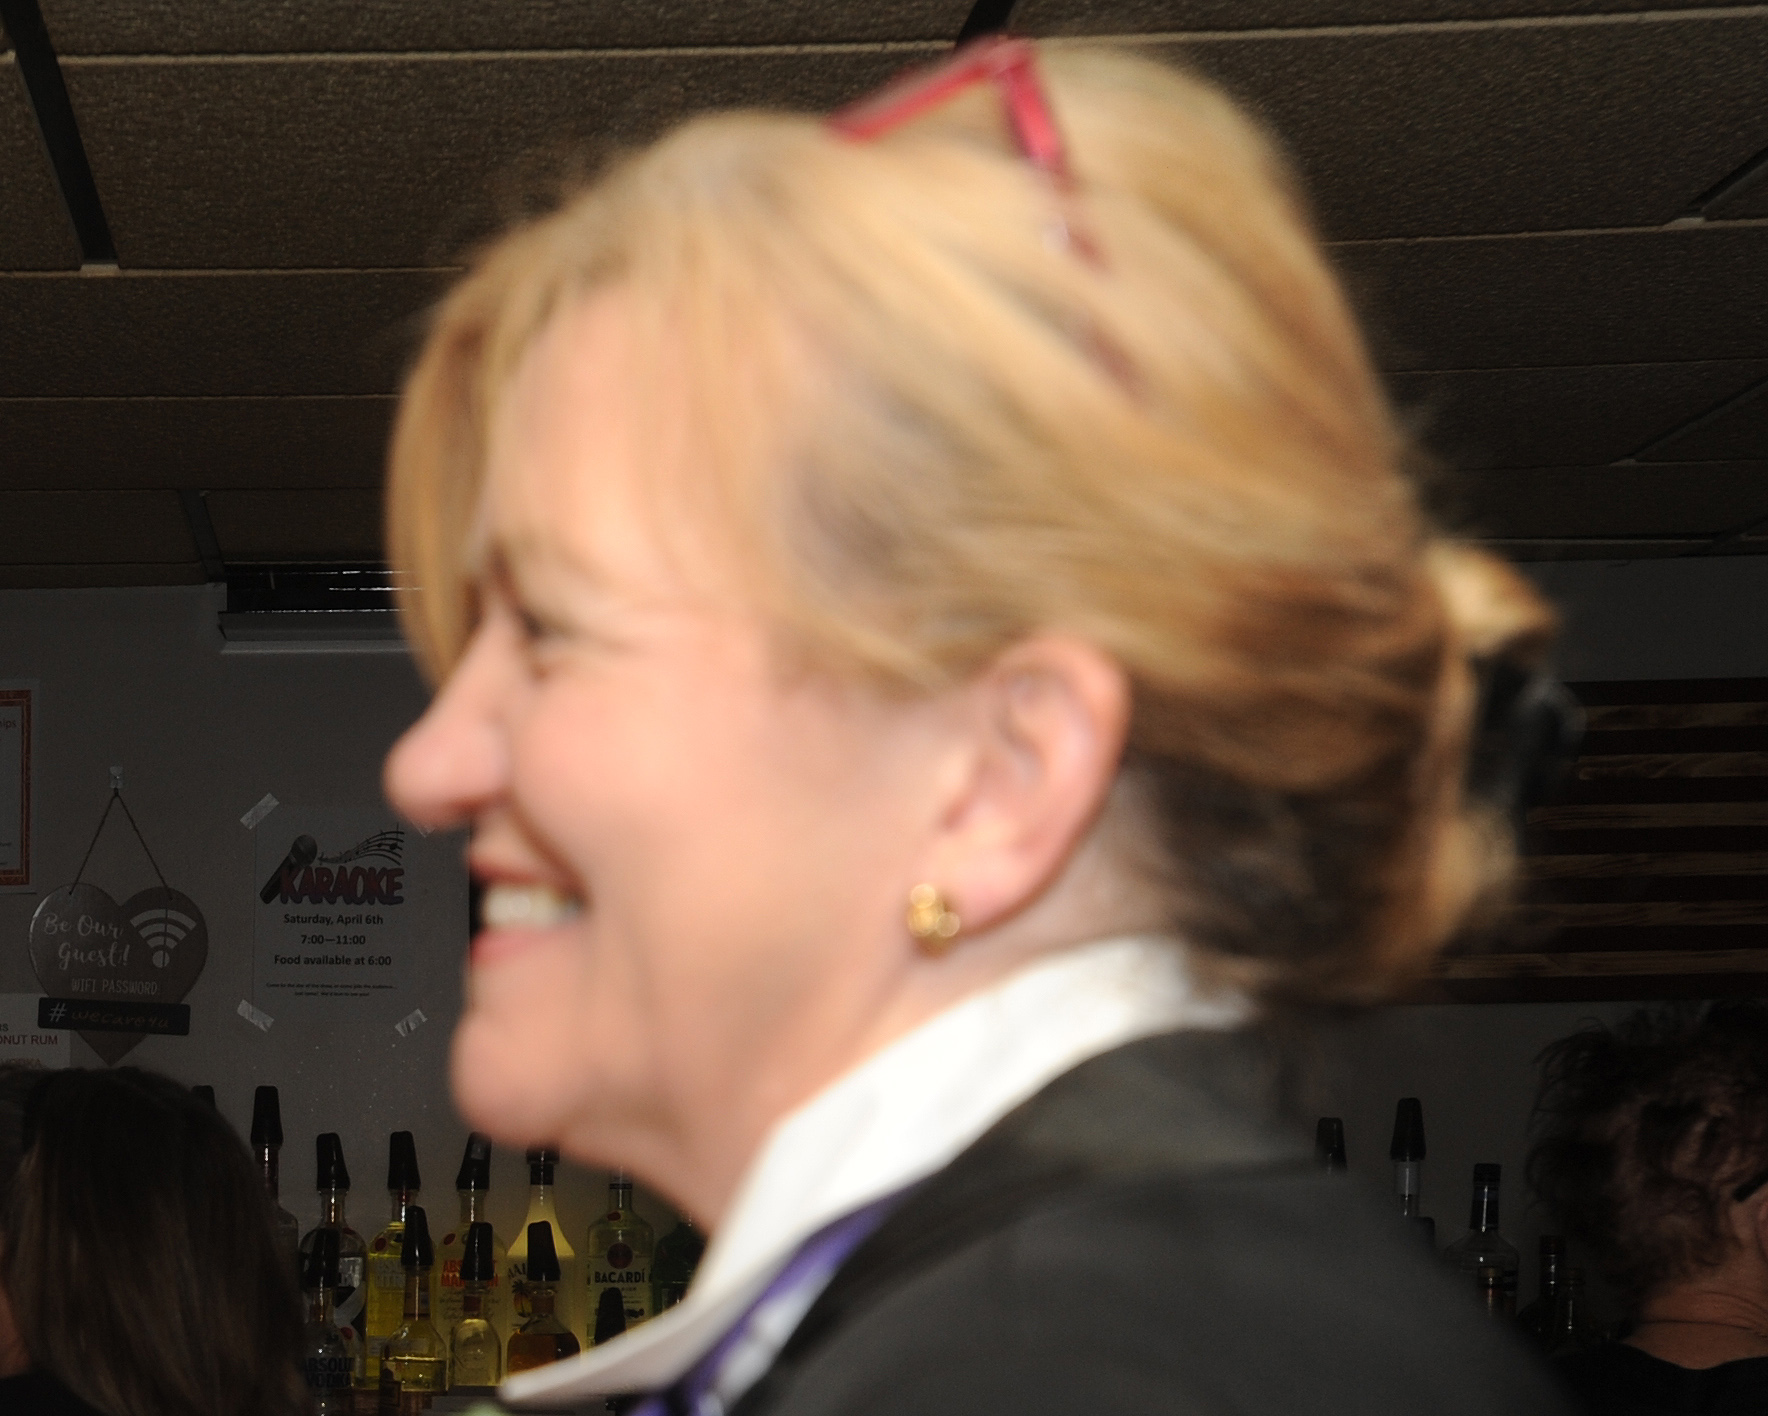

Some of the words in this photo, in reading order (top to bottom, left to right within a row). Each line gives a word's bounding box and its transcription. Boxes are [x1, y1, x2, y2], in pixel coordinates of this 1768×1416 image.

[280, 865, 404, 905] KARAOKE
[44, 912, 71, 935] Be
[78, 914, 124, 940] Our
[284, 913, 333, 926] Saturday,
[337, 914, 363, 926] April
[365, 914, 384, 925] 6th
[58, 942, 130, 971] Guest!
[274, 955, 301, 965] Food
[304, 955, 352, 966] available
[354, 956, 365, 966] at
[368, 956, 392, 966] 6:00
[71, 978, 96, 993] WIFI
[31, 1035, 58, 1045] RUM
[594, 1268, 645, 1283] BACARDÍ
